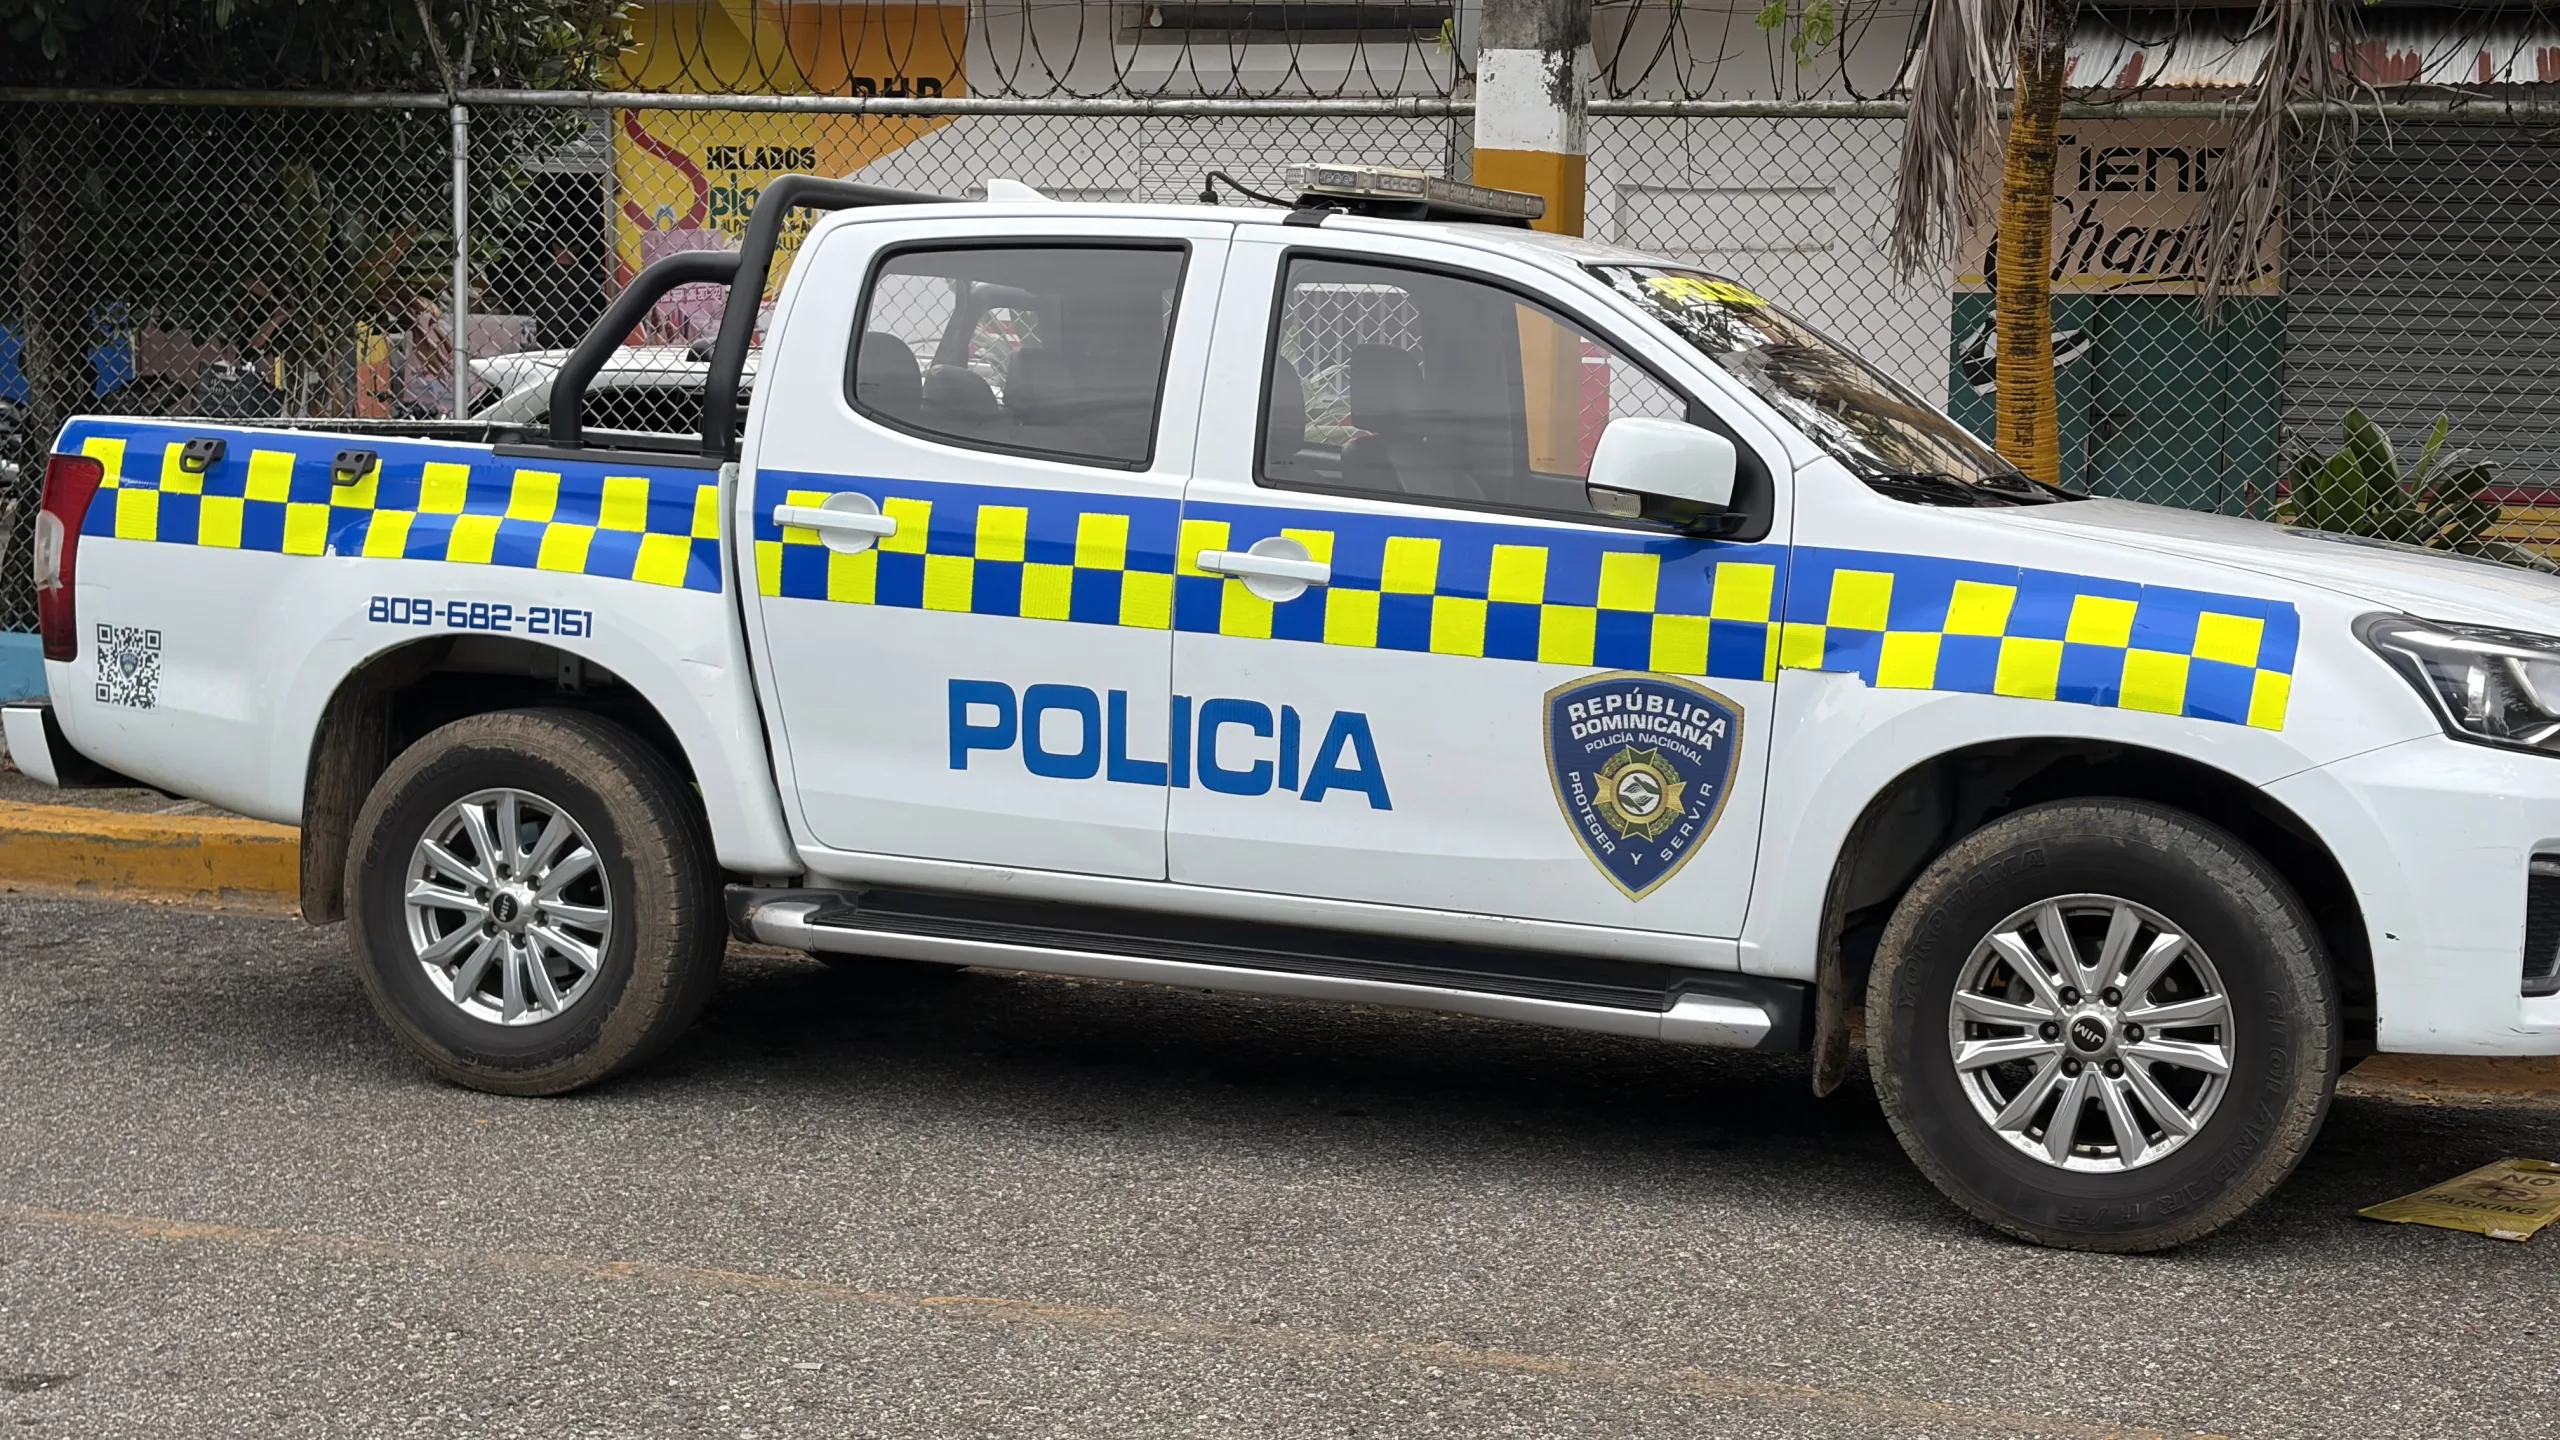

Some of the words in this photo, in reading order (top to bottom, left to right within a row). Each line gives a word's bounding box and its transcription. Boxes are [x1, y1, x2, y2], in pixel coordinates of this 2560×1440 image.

[707, 146, 816, 171] HELADOS
[2057, 134, 2269, 193] IEND
[369, 596, 593, 638] 809-682-2151
[1567, 687, 1727, 738] REPÚBLICA
[1571, 714, 1714, 750] DOMINICANA
[948, 678, 1393, 811] POLICIA
[1585, 731, 1634, 753] POLICÍA
[1638, 732, 1702, 766] NACIONAL
[1568, 771, 1616, 855] PROTEGER
[1630, 852, 1643, 865] Y
[1660, 782, 1713, 862] SERVIR
[2501, 1173, 2557, 1187] NO
[2422, 1193, 2540, 1216] PARKING
